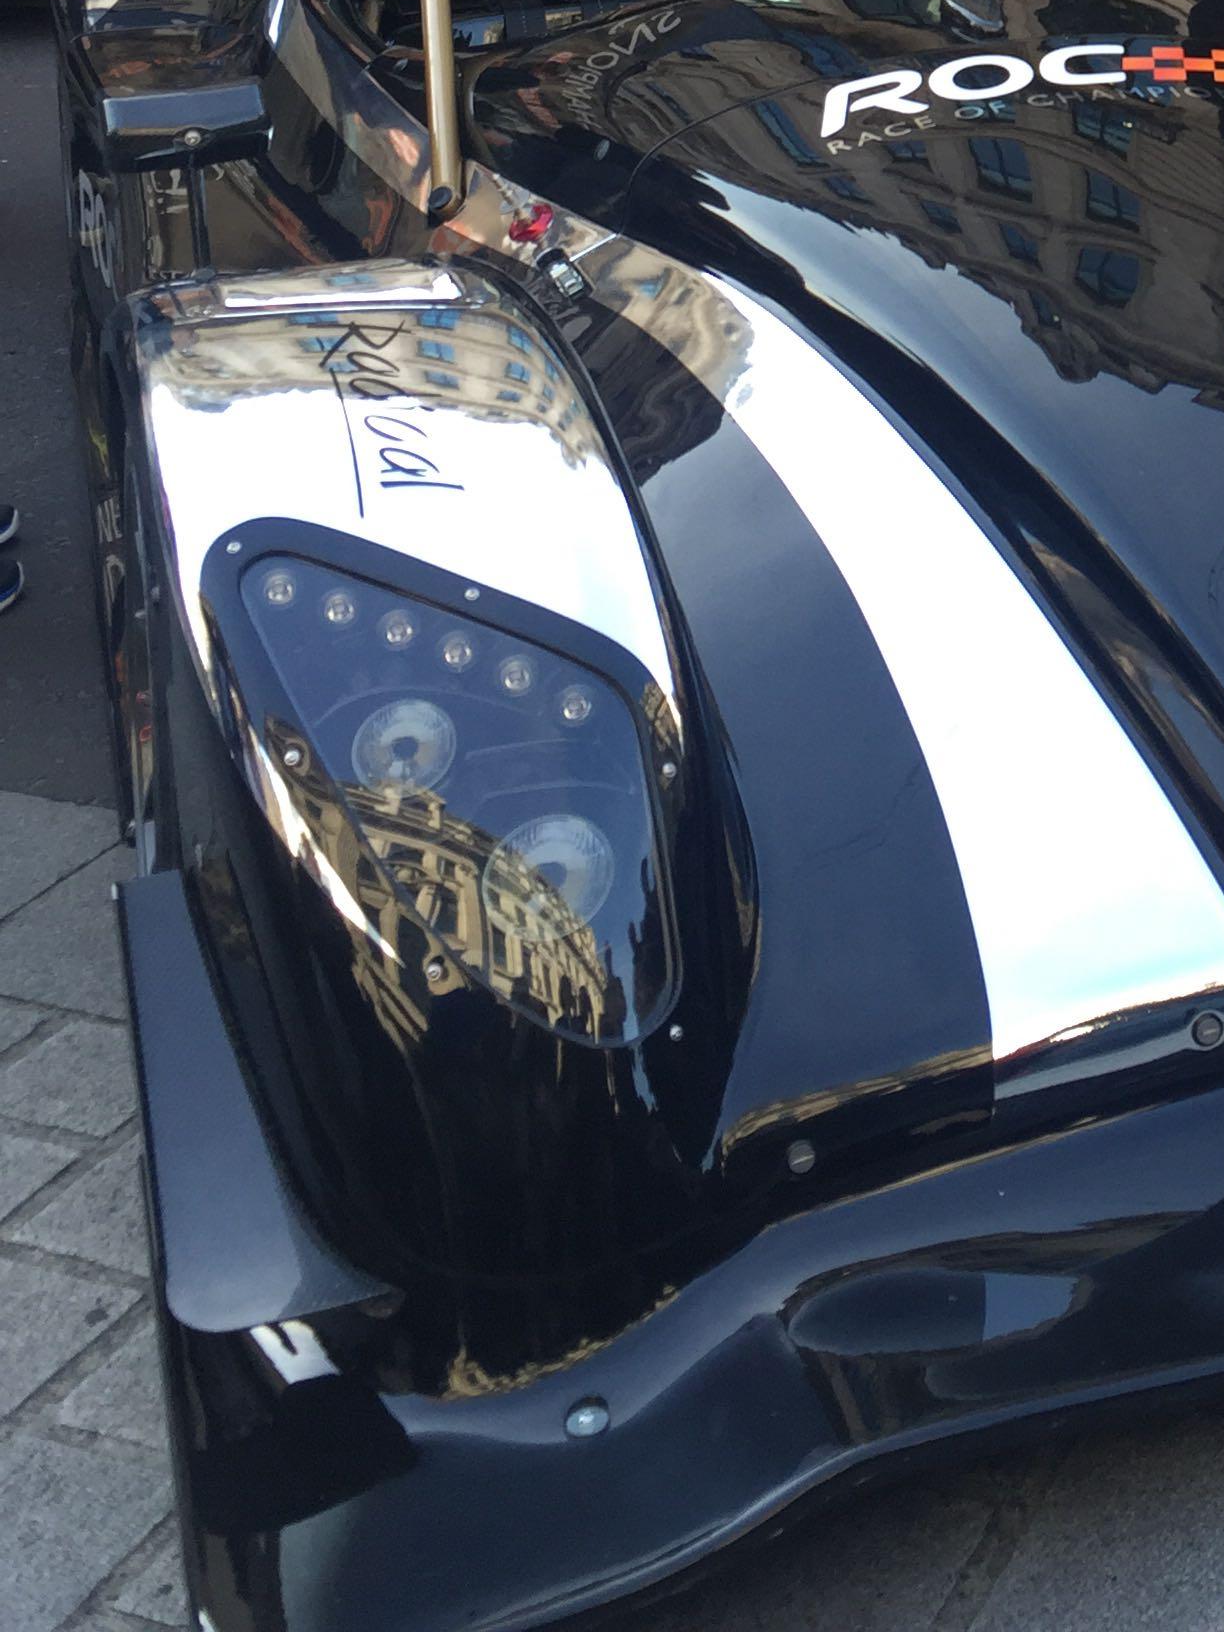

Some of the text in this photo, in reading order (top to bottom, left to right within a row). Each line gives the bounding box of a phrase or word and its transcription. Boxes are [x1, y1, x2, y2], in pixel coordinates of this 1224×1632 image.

[820, 43, 1127, 138] ROC
[826, 114, 937, 157] RACE
[954, 100, 1014, 122] OF
